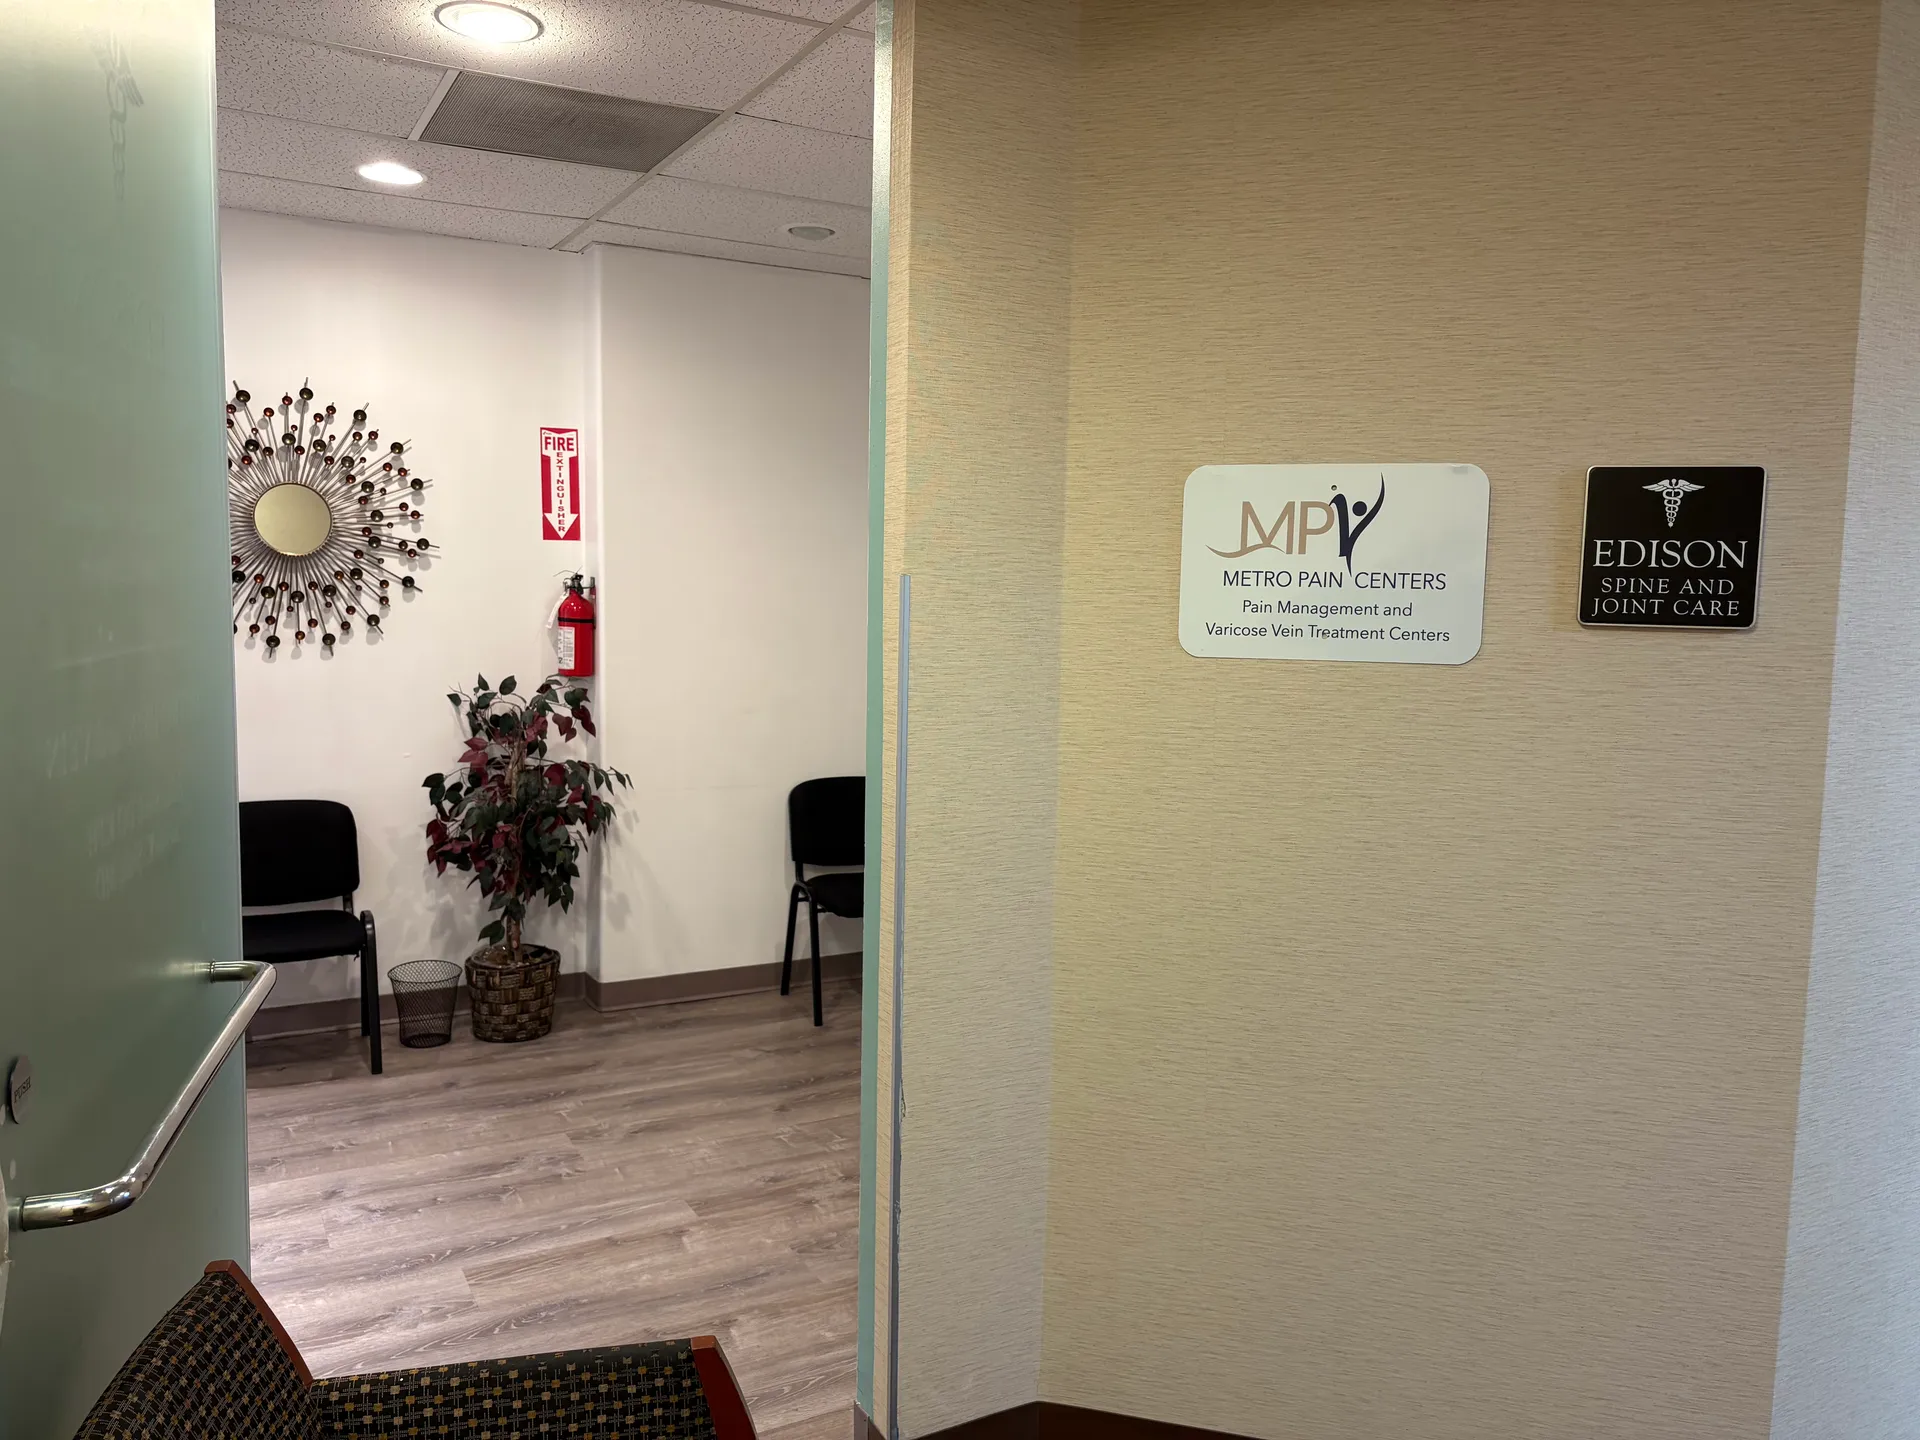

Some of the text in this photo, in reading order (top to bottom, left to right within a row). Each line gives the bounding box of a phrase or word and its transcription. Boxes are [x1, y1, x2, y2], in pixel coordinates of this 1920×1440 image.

[544, 436, 575, 451] FIRE
[555, 452, 566, 532] EXTINGUISHER
[1592, 539, 1748, 569] EDISON
[1223, 570, 1447, 591] METRO PAIN CENTERS
[1601, 577, 1734, 595] SPINE AND
[1242, 599, 1413, 619] Pain Management and
[1591, 598, 1740, 617] JOINT CARE
[1205, 621, 1450, 642] Varicose Vein Treatment Centers
